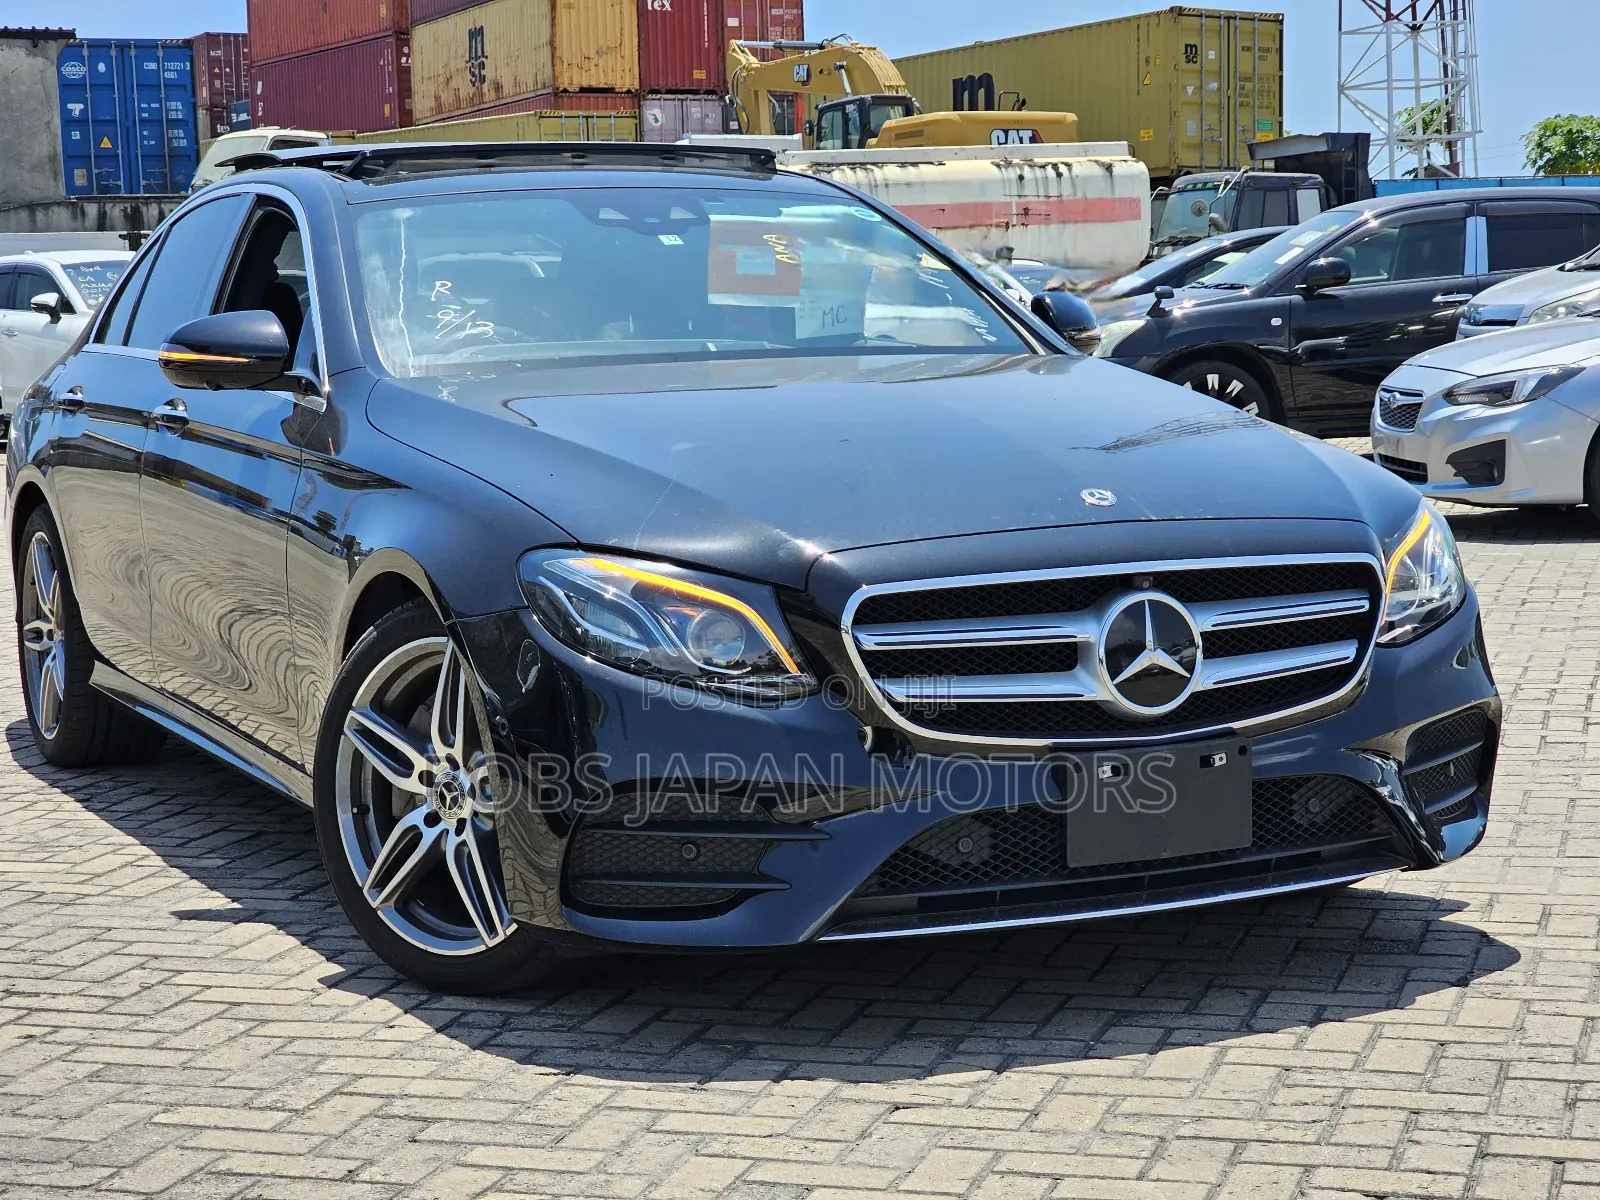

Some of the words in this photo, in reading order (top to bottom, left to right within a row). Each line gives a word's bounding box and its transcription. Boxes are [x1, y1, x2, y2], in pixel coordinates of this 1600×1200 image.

[163, 62, 184, 70] 712721
[793, 64, 808, 82] CAT
[163, 71, 178, 79] 45G1
[990, 129, 1032, 145] CAT
[430, 280, 453, 302] R
